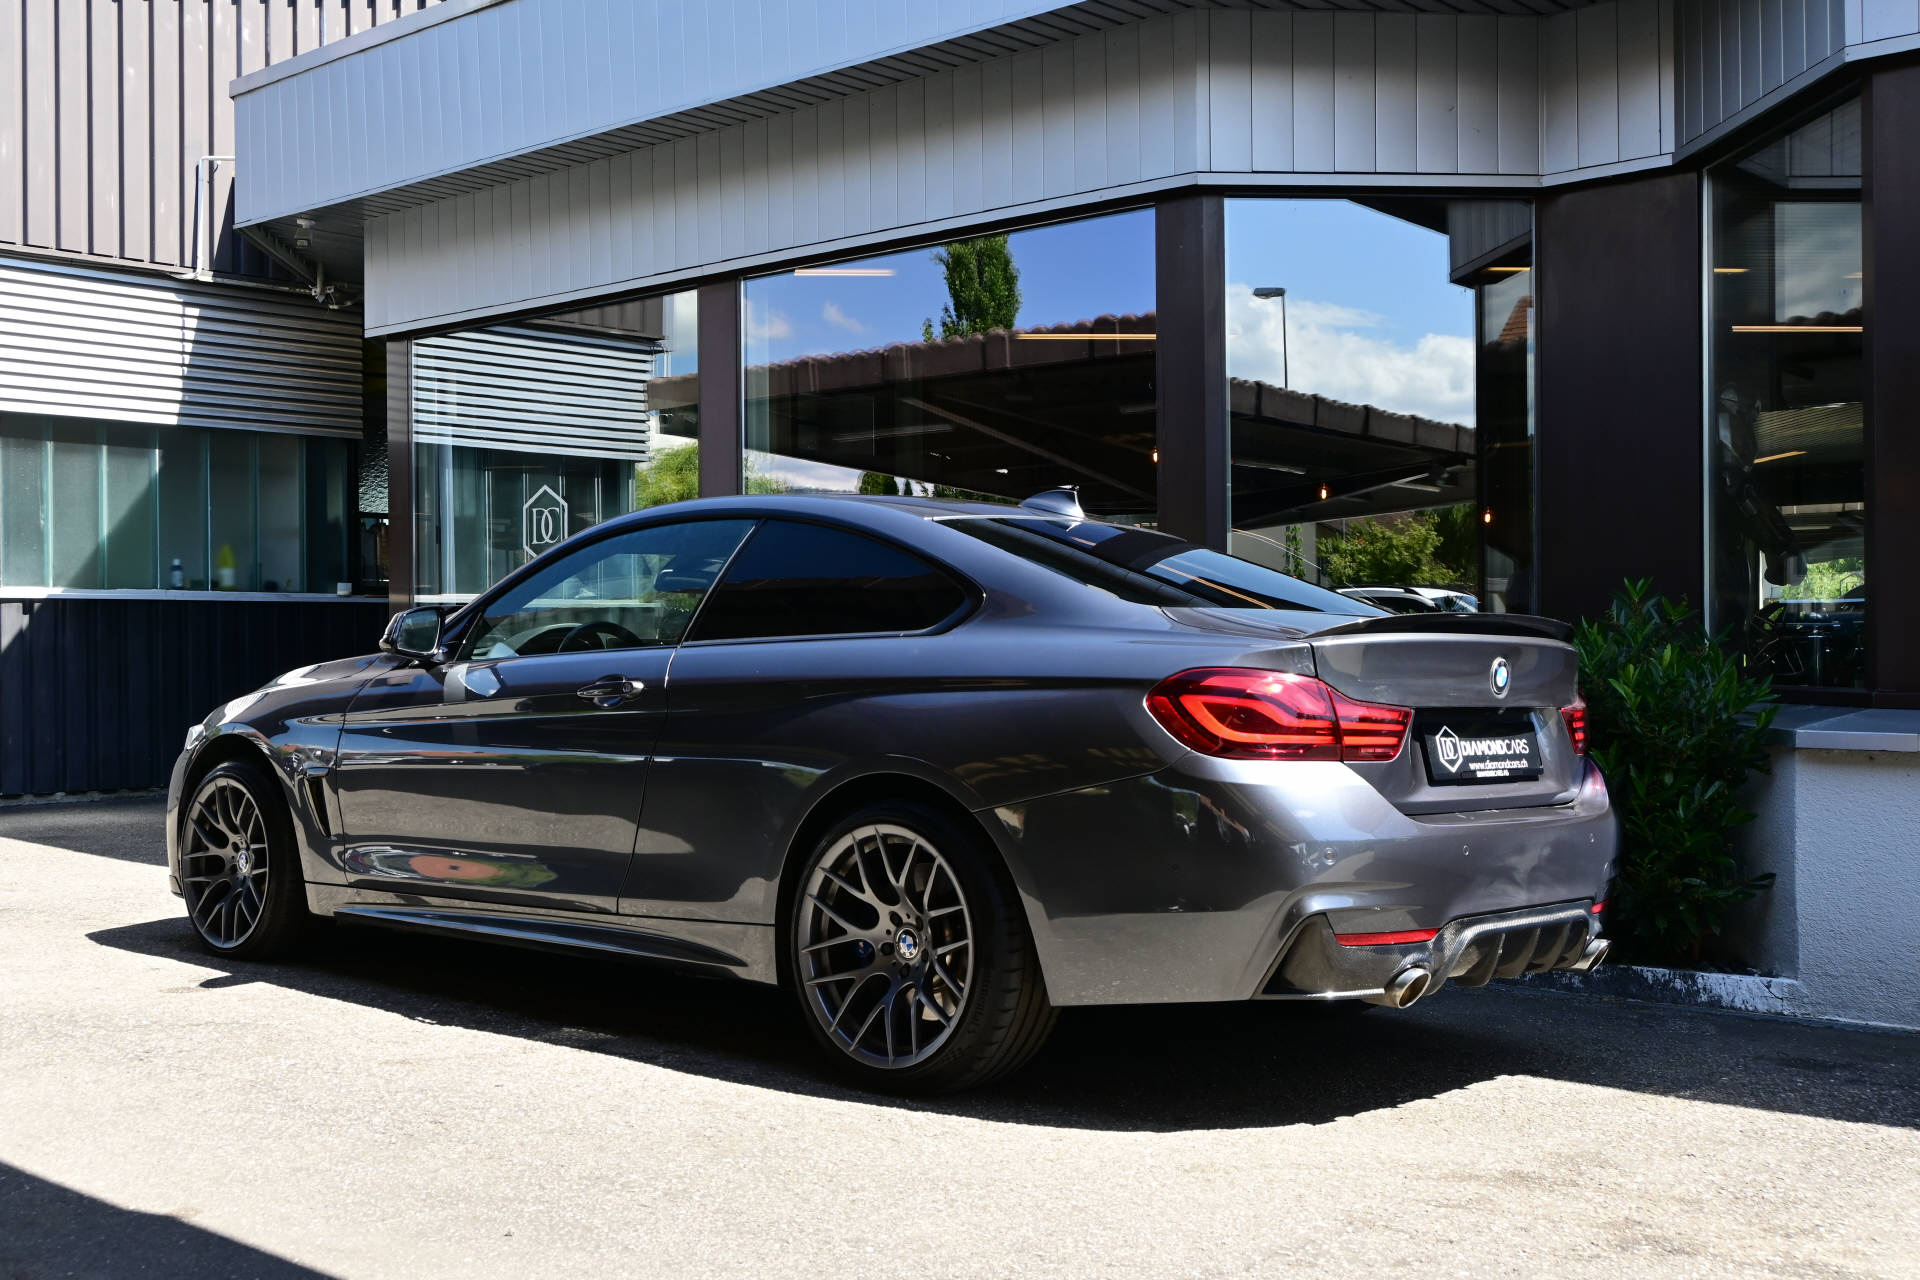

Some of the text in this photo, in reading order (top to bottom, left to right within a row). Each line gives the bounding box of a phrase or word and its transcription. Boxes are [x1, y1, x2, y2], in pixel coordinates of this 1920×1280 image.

[531, 507, 560, 545] DC
[1440, 737, 1529, 760] DC DIAMONDCARS
